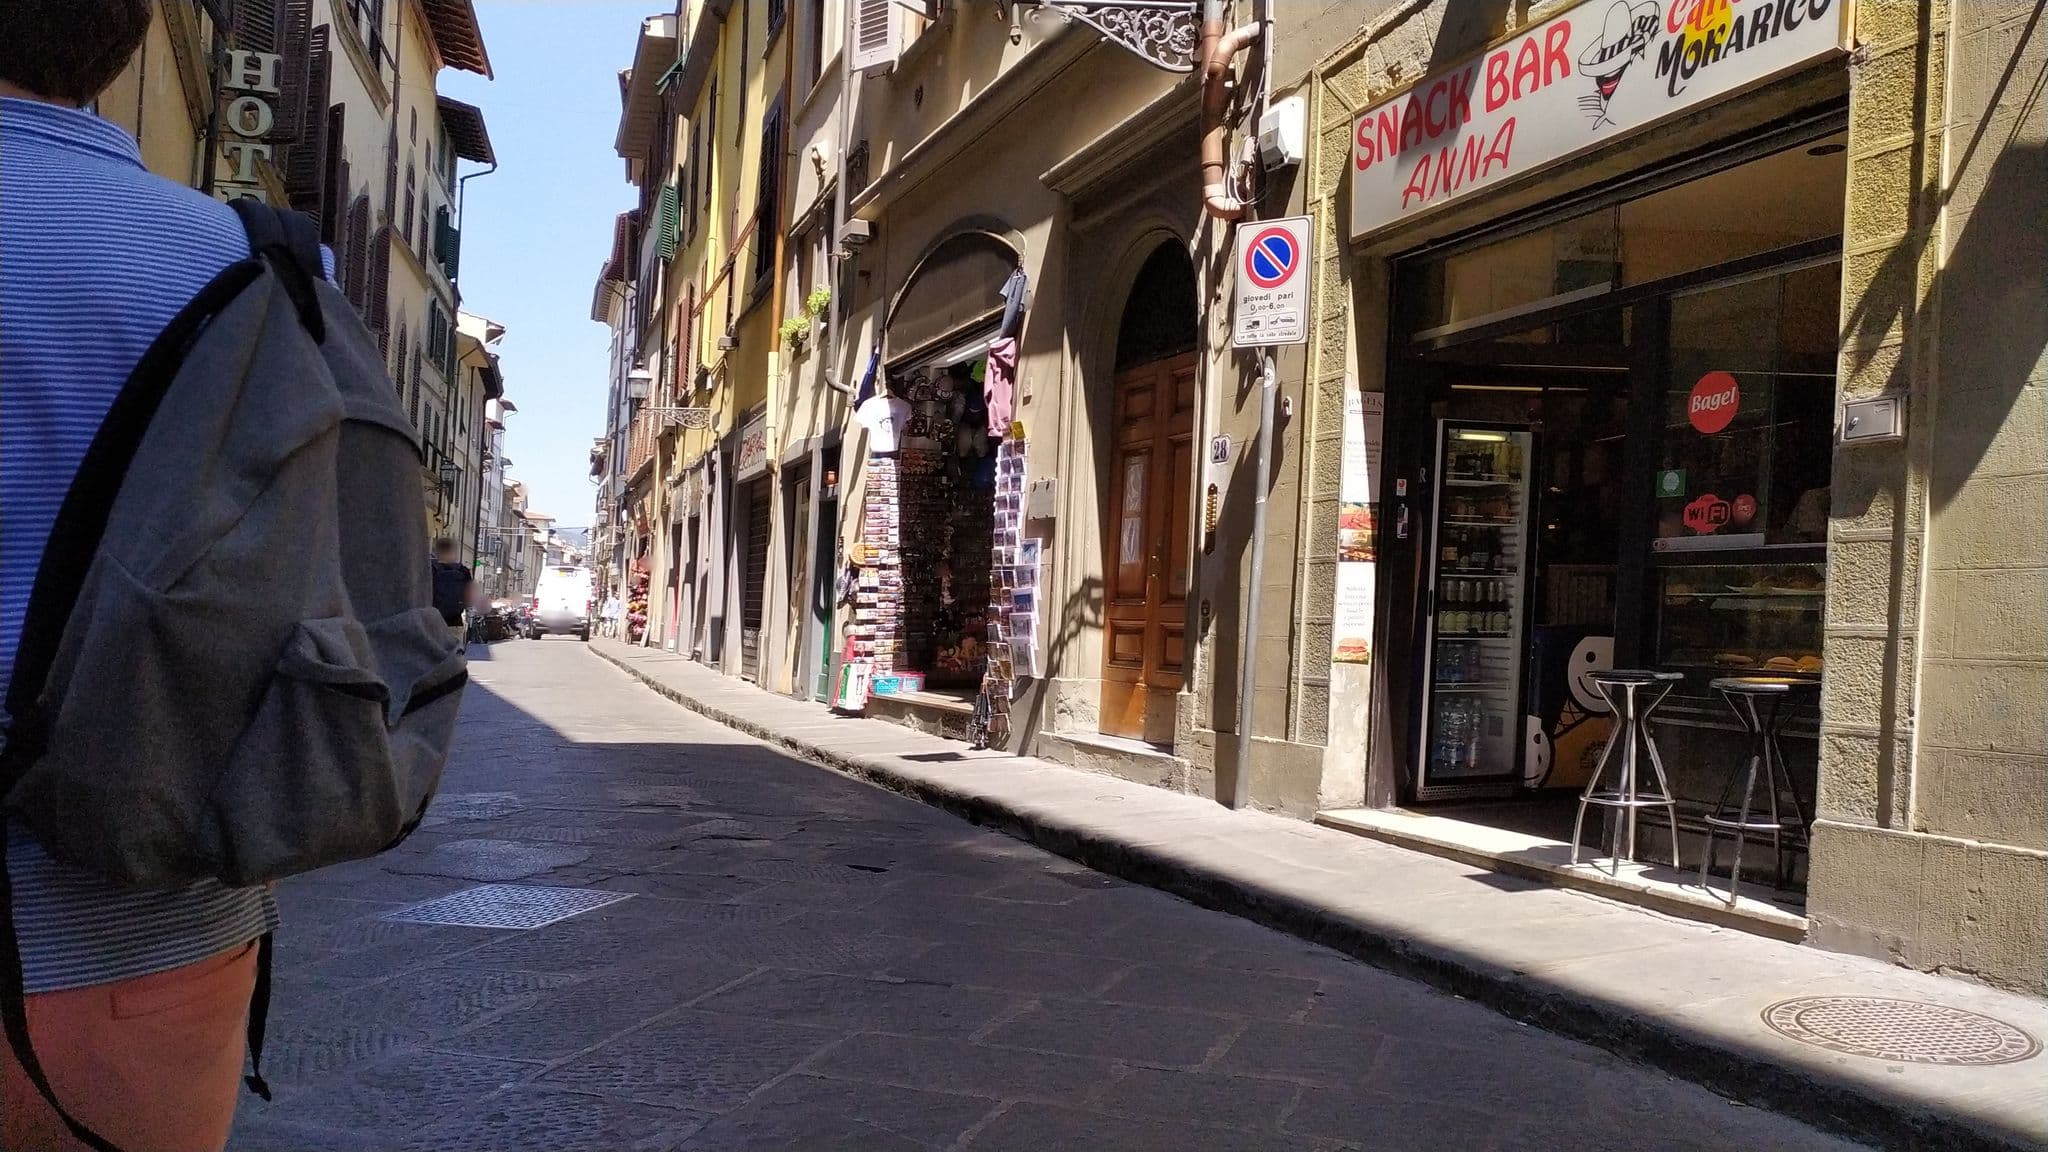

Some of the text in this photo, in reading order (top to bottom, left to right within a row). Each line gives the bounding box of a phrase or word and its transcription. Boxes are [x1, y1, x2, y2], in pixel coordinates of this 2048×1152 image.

[1355, 19, 1572, 171] SNACK BAR
[1402, 116, 1516, 209] ANNA
[1278, 292, 1294, 301] pari
[1691, 386, 1736, 413] Bagel
[1213, 440, 1227, 460] 28
